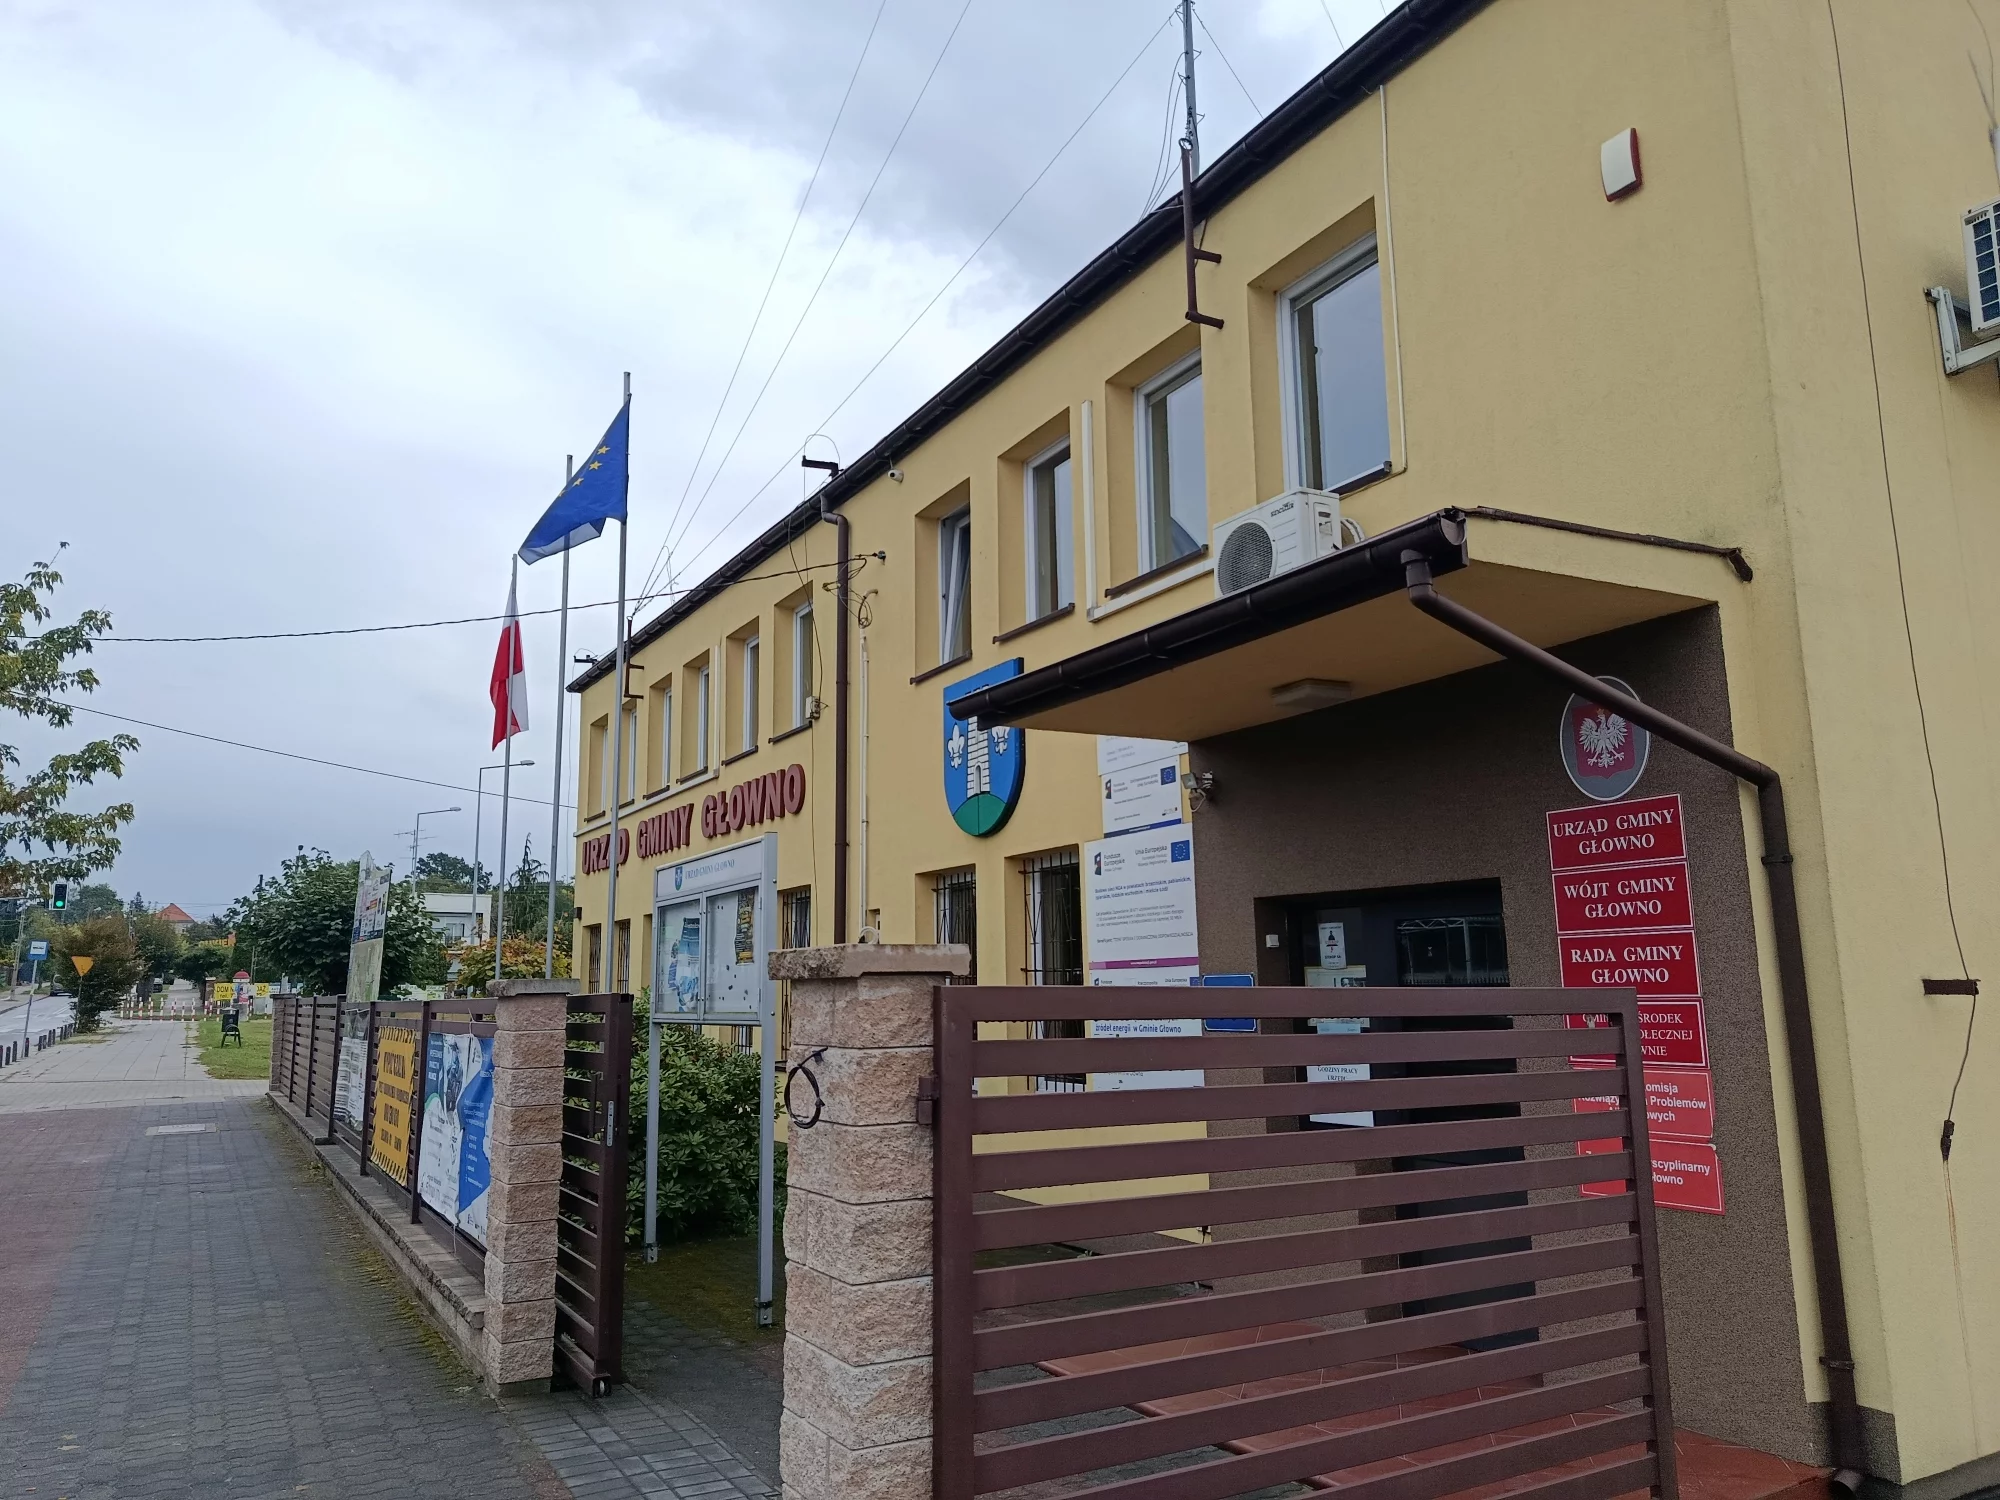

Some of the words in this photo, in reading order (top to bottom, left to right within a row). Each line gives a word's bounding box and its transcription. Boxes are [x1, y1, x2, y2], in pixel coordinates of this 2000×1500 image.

[636, 803, 695, 860] GMINY
[701, 763, 807, 839] GŁOWNO
[1553, 817, 1609, 838] URZĄD
[1615, 808, 1675, 830] GMINY
[1578, 833, 1655, 855] GŁOWNO
[1563, 880, 1610, 899] WÓJT
[1617, 876, 1677, 896] GMINY
[1585, 899, 1662, 919] GŁOWNO
[1571, 948, 1617, 963] RADA
[1623, 945, 1683, 962] GMINY
[1591, 967, 1670, 984] GŁOWNO
[1112, 1023, 1131, 1034] energii
[1138, 1023, 1158, 1033] Gminie
[1159, 1023, 1182, 1034] Głowno
[1645, 1082, 1679, 1096] omisja
[1650, 1095, 1707, 1109] Problemów
[1652, 1172, 1684, 1186] łowno
